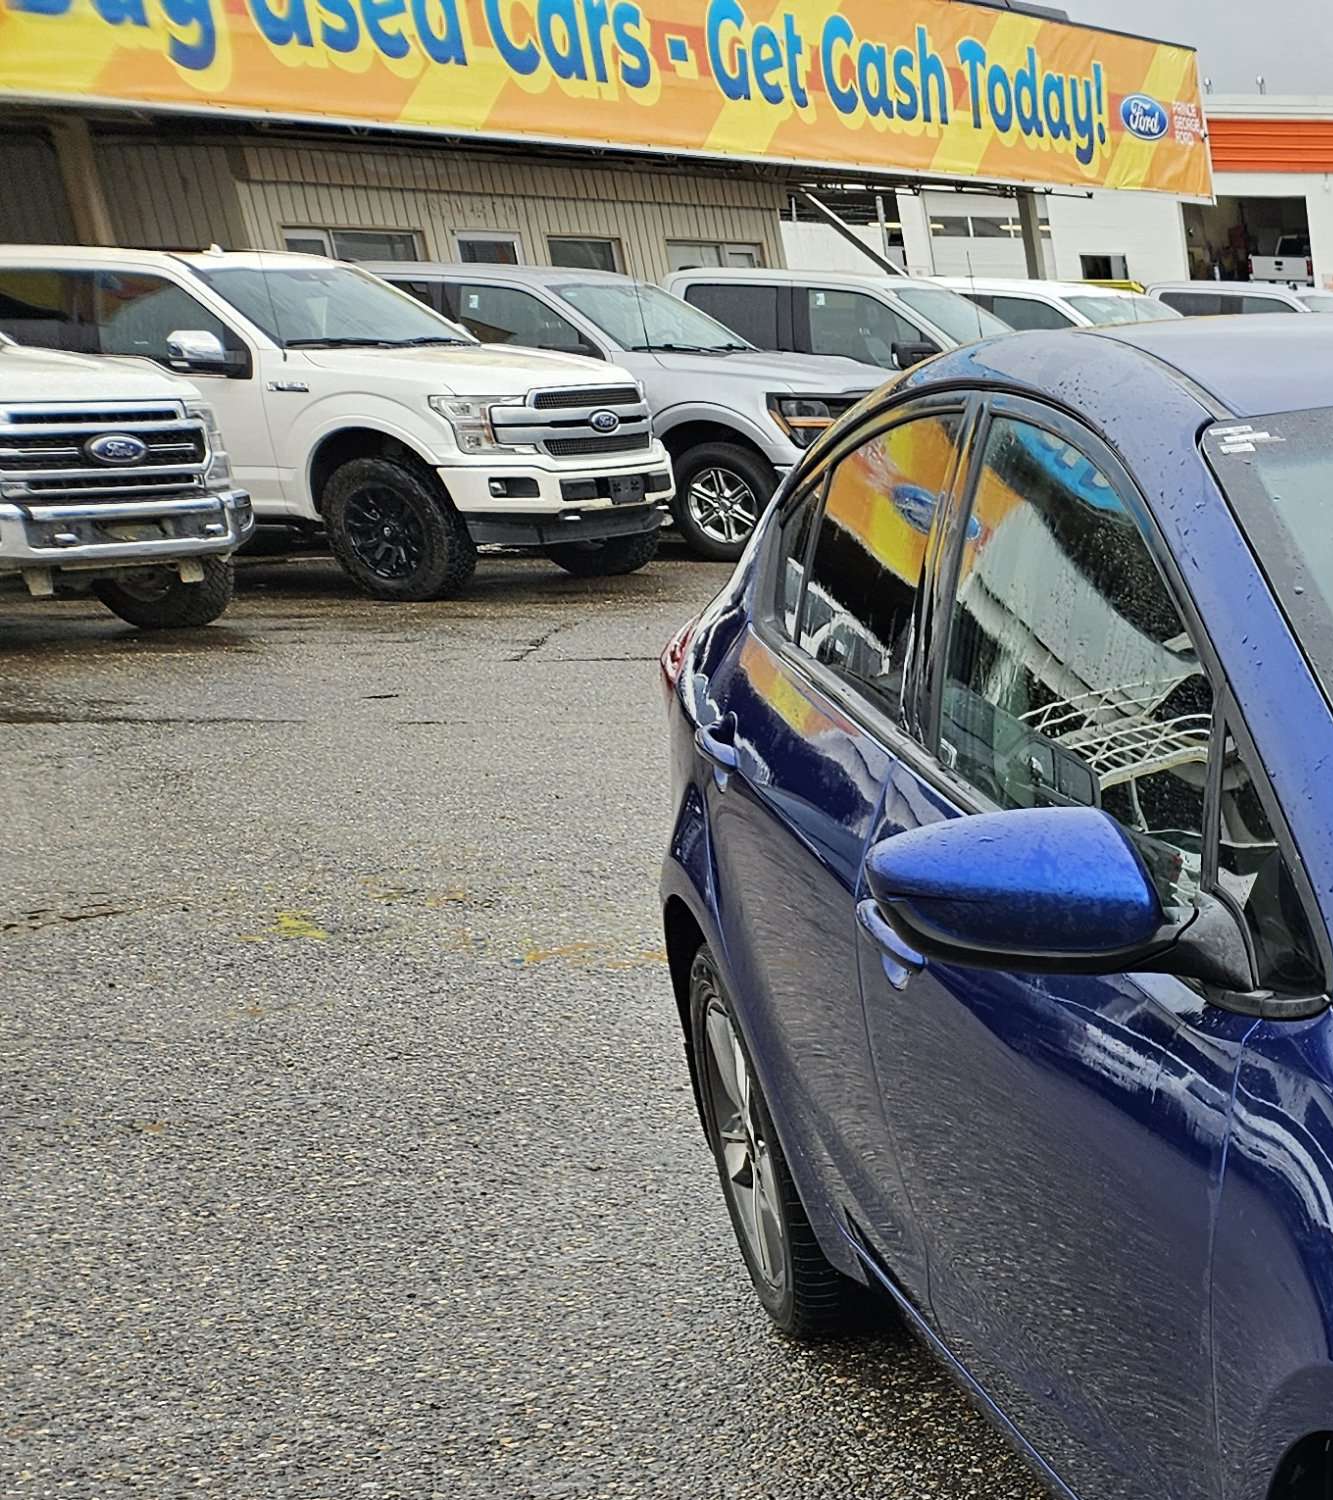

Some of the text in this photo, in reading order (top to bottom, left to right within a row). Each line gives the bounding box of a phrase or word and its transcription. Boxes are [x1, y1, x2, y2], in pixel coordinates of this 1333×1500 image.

[484, 0, 651, 89] Cars
[706, 0, 808, 108] Get
[820, 14, 949, 124] Cash
[957, 38, 1107, 166] Today!
[1129, 99, 1160, 134] Ford
